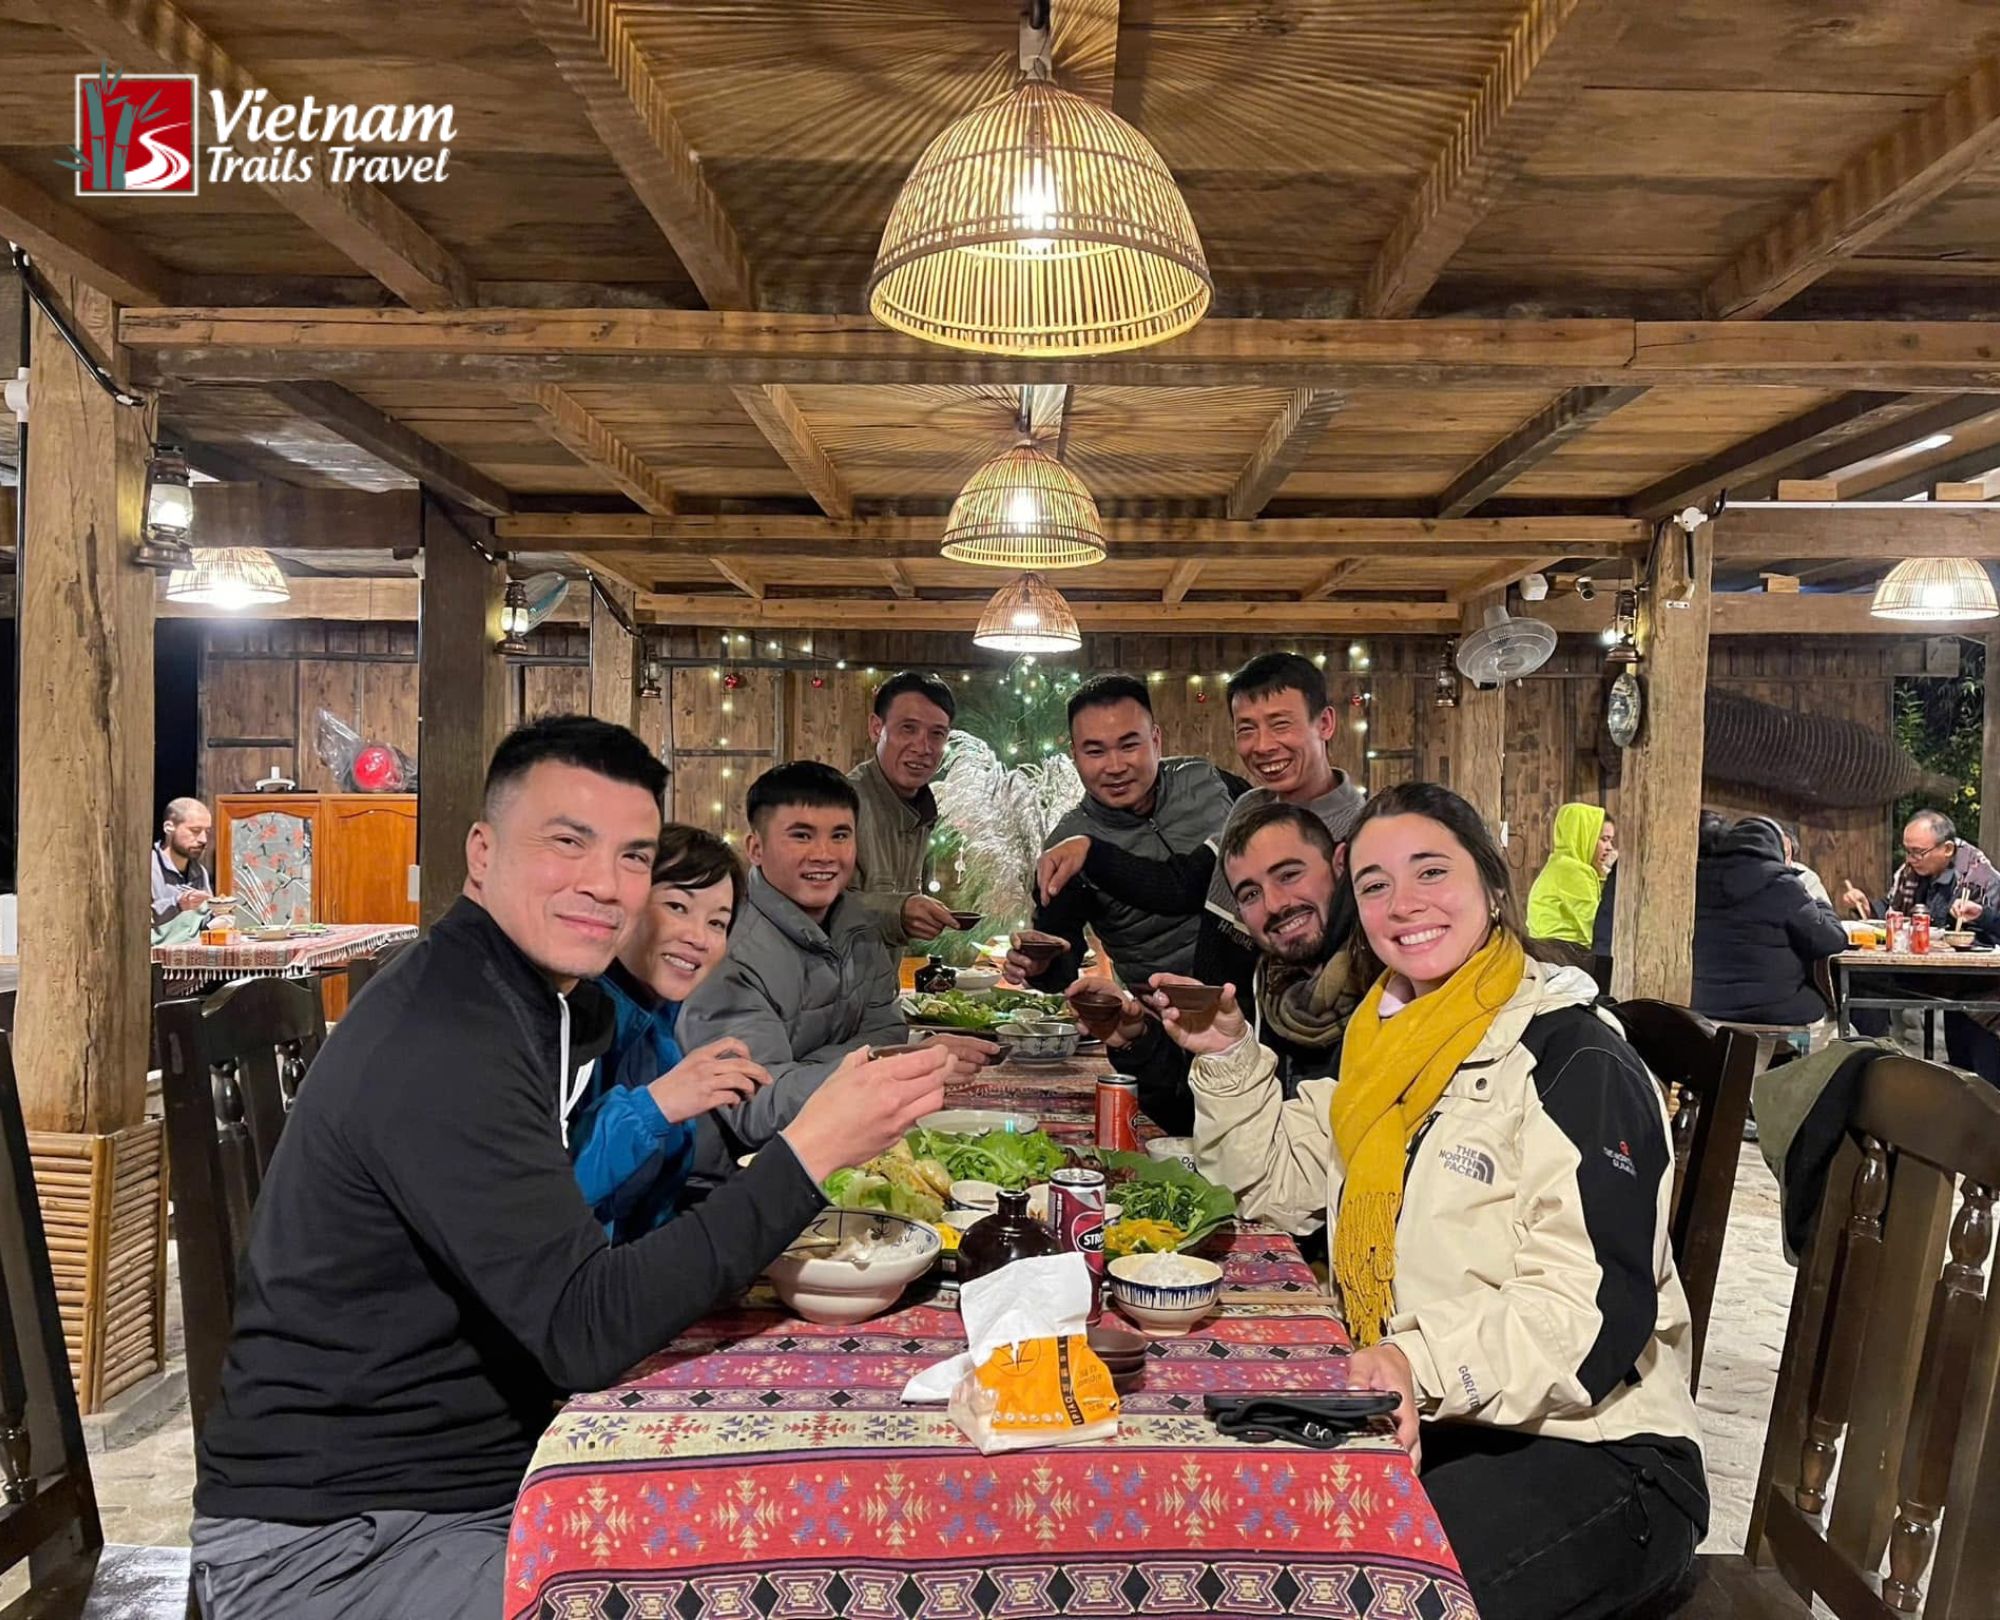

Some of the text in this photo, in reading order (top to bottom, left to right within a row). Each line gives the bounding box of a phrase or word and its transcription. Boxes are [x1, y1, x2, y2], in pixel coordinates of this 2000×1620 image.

[1438, 1149, 1478, 1169] NORTH
[1456, 1144, 1478, 1159] THE
[1443, 1160, 1473, 1178] FACE
